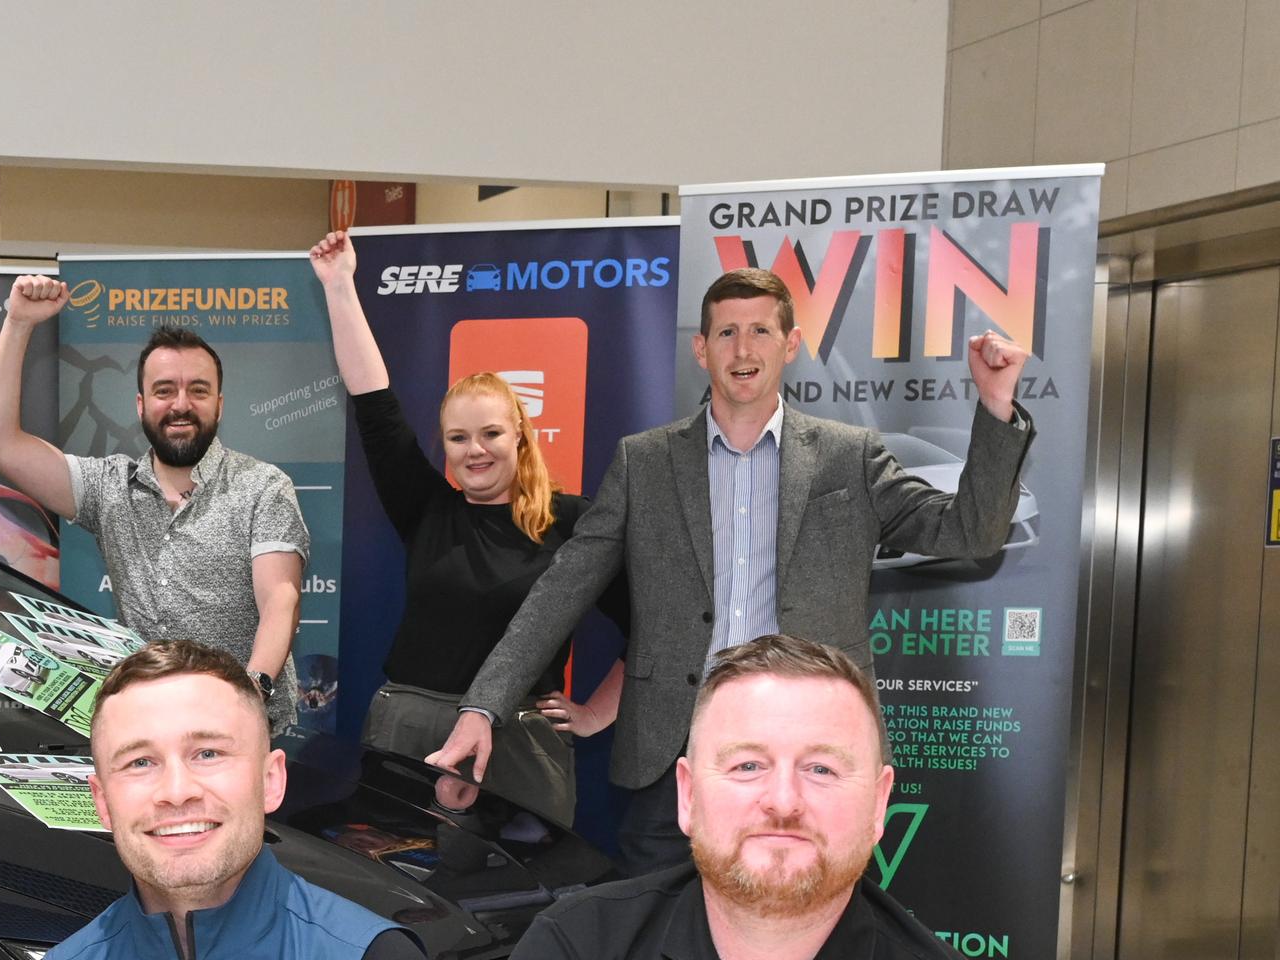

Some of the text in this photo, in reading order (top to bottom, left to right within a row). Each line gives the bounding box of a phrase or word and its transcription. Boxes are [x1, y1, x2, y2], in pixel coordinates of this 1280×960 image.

[709, 187, 1060, 229] GRAND PRIZE DRAW
[377, 257, 670, 295] SERE MOTORS
[108, 288, 289, 311] PRIZEFUNDER
[713, 222, 1051, 366] WIN
[108, 315, 145, 327] RAISE
[209, 315, 237, 326] WIN
[242, 314, 290, 326] PRIZES
[249, 382, 311, 417] Supporting
[833, 380, 894, 402] NEW
[903, 377, 975, 400] SEAT
[1013, 376, 1060, 399] IZA
[265, 395, 337, 431] Communities
[869, 609, 992, 632] AN HERE
[902, 633, 990, 656] ENTER
[899, 706, 928, 716] THIS
[932, 706, 978, 718] BRAND
[982, 707, 1013, 718] NEW
[933, 719, 972, 731] RAISE
[976, 720, 1021, 732] FUNDS
[887, 731, 1002, 745] SO THAT WE CAN
[924, 745, 985, 758] SERVICES
[991, 748, 1009, 758] TO
[928, 758, 977, 770] ISSUES!
[901, 784, 922, 794] US!
